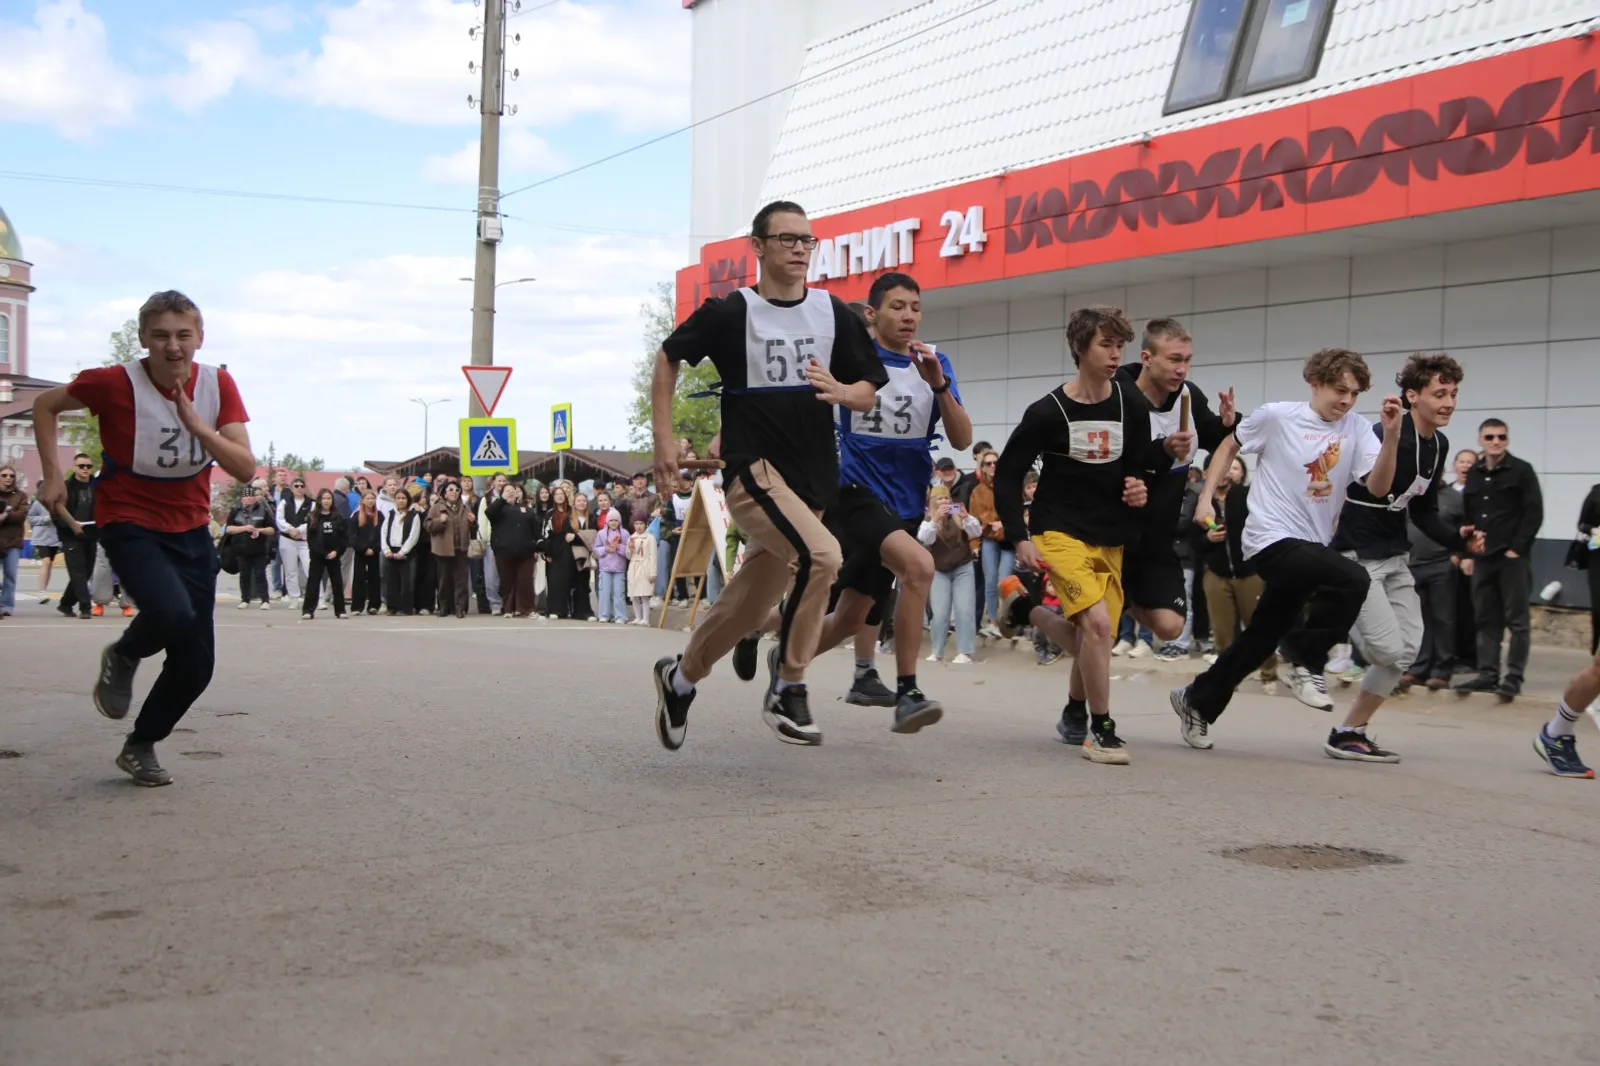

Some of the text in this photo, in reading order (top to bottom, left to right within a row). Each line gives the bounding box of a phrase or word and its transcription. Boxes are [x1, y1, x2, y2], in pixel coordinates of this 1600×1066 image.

[757, 205, 988, 283] АГНИТ 24
[765, 338, 815, 383] 55
[862, 395, 912, 434] 43
